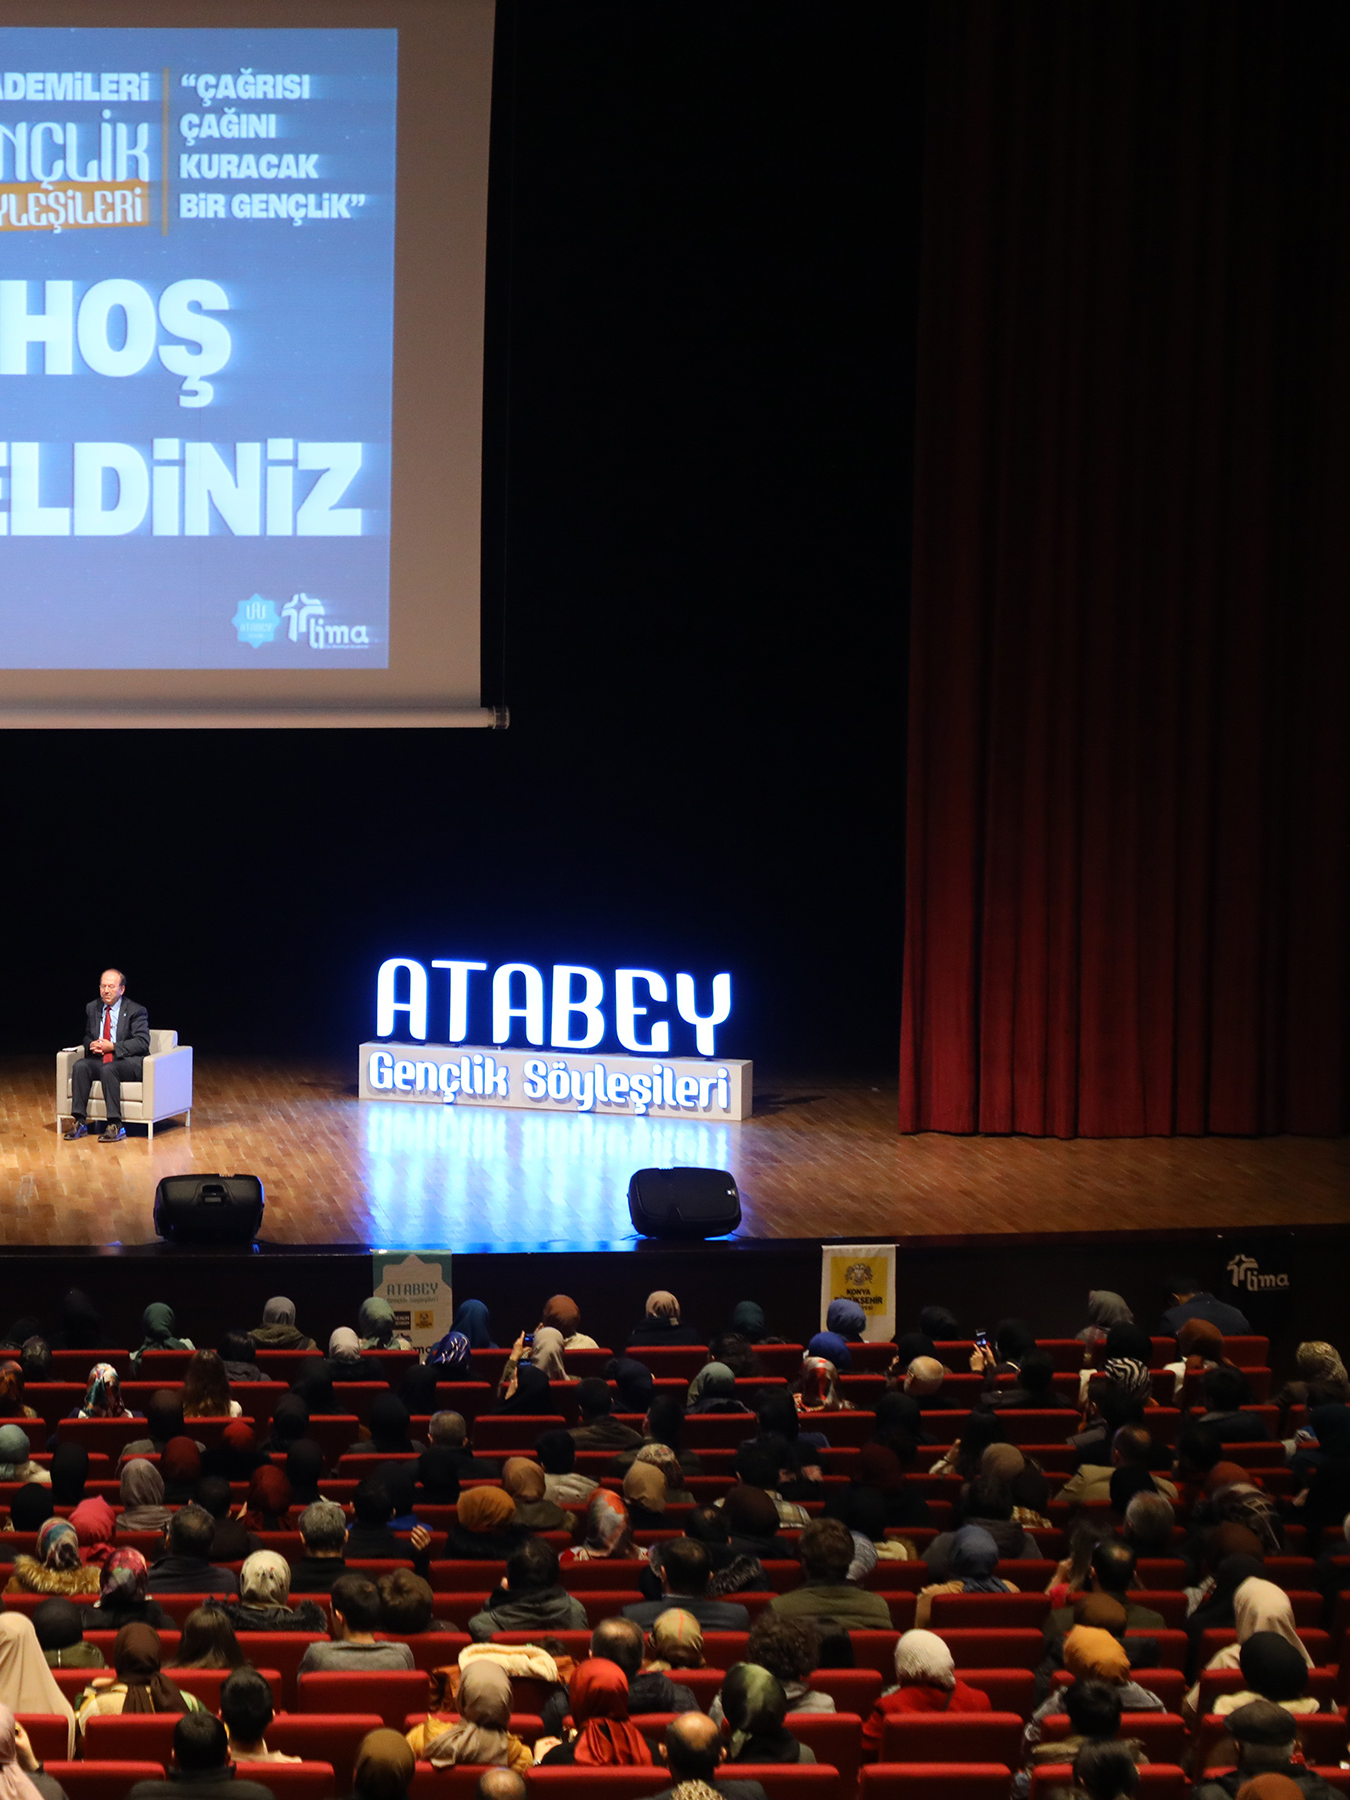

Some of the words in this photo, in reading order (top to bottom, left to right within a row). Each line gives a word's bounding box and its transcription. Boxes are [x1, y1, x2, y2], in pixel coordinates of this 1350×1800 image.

[180, 108, 276, 146] ÇAĞINI
[180, 154, 319, 180] KURACAK
[309, 618, 370, 650] lima
[376, 957, 732, 1056] ATABEY
[368, 1050, 510, 1103] Gençlik
[522, 1057, 729, 1115] Söyleşileri
[386, 1282, 438, 1296] ATABEY
[1247, 1270, 1290, 1291] lima
